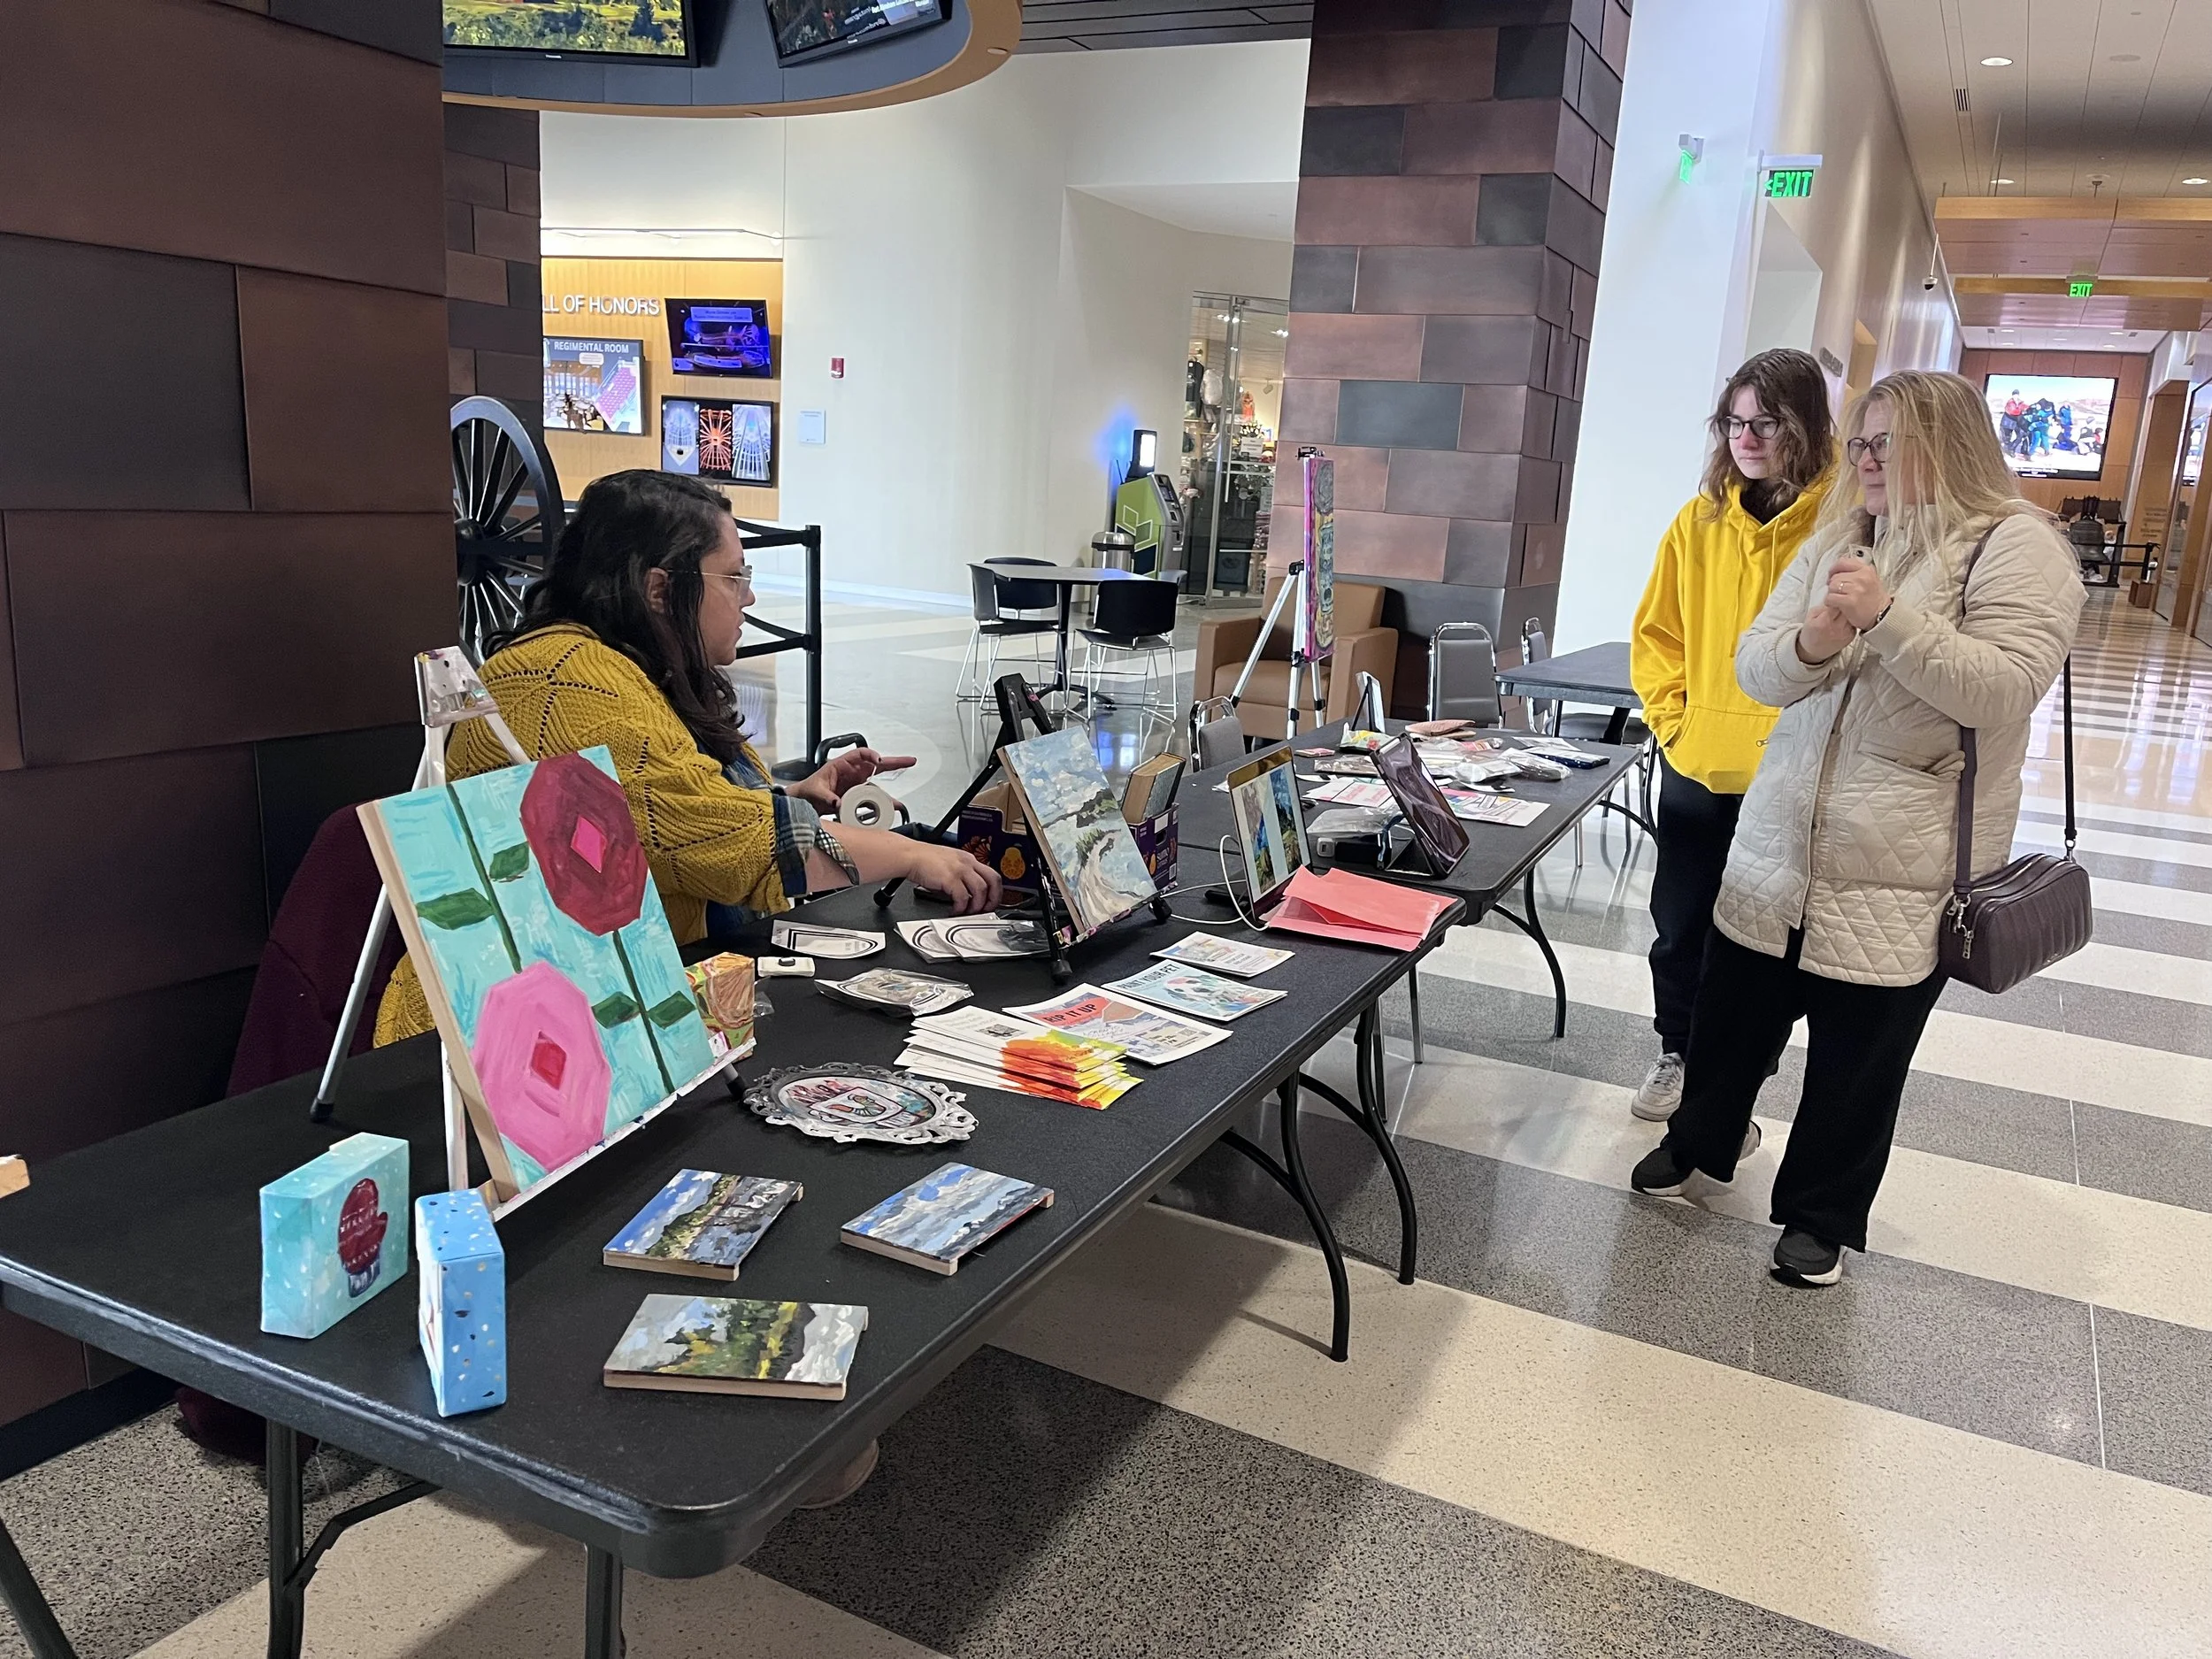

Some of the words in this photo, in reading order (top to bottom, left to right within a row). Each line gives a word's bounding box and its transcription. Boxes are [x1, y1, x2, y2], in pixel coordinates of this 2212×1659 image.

[1771, 171, 1813, 197] EXIT
[2070, 283, 2093, 297] EXIT
[563, 294, 585, 312] OF
[589, 296, 660, 315] HONORS
[554, 342, 603, 352] REGIMENTAL
[604, 343, 629, 353] ROOM
[1140, 971, 1166, 982] YOUR
[1159, 964, 1180, 973] PET
[1079, 1004, 1097, 1013] UP
